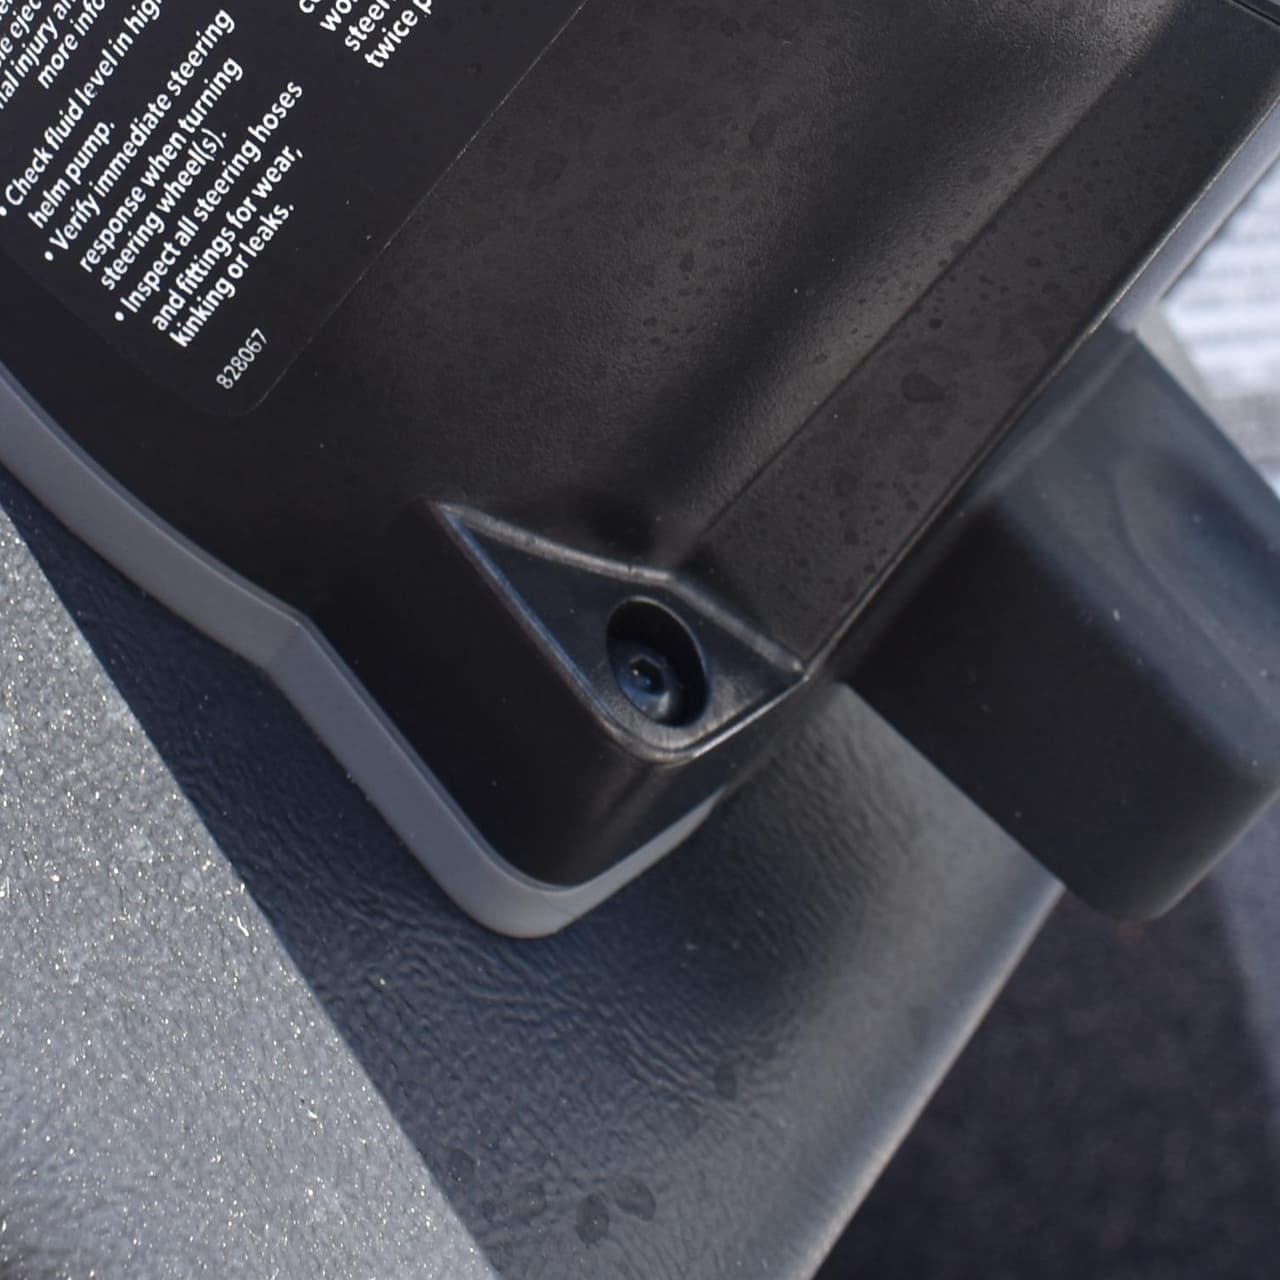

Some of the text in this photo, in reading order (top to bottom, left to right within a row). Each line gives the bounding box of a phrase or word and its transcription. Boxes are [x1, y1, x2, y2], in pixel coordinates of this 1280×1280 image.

[9, 14, 59, 79] injury
[36, 32, 80, 90] more
[363, 9, 419, 69] twice
[4, 146, 55, 207] Check
[43, 96, 85, 152] fluid
[73, 47, 119, 107] level
[107, 31, 134, 58] in
[26, 121, 116, 230] helm pump.
[48, 8, 236, 251] Verify immediate steering
[79, 57, 244, 274] response when turning
[100, 126, 228, 292] steering wheel(s).
[119, 81, 304, 314] Inspect all steering hoses
[151, 144, 304, 332] and fittings for wear,
[168, 203, 295, 348] kinking or leaks.
[215, 327, 267, 390] 828067
